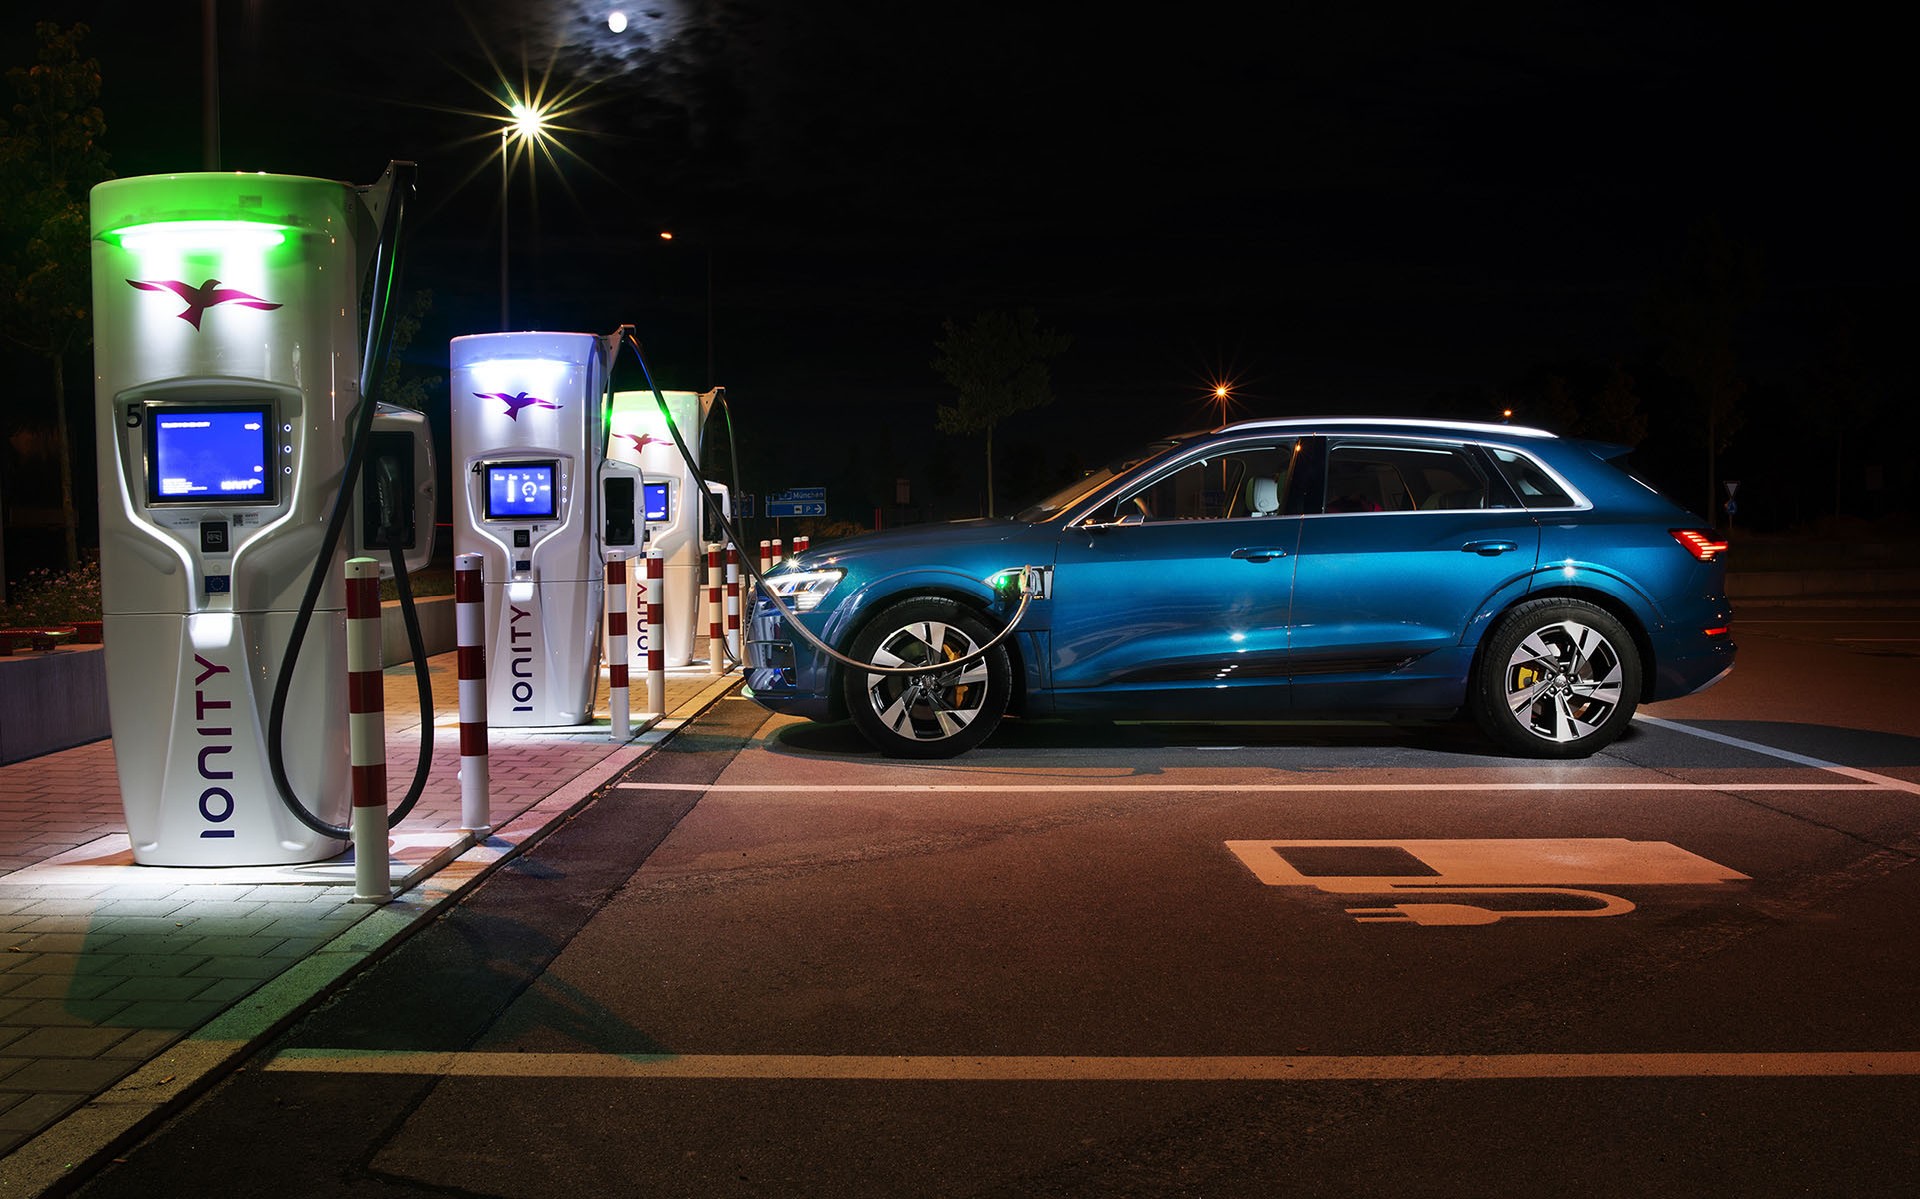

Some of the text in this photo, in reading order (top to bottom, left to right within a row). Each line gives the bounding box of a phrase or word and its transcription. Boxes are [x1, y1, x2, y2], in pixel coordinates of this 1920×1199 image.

[127, 403, 142, 428] 5
[471, 461, 482, 475] 4
[793, 490, 824, 499] München
[510, 604, 533, 712] IONITY
[194, 653, 236, 839] IONITY
